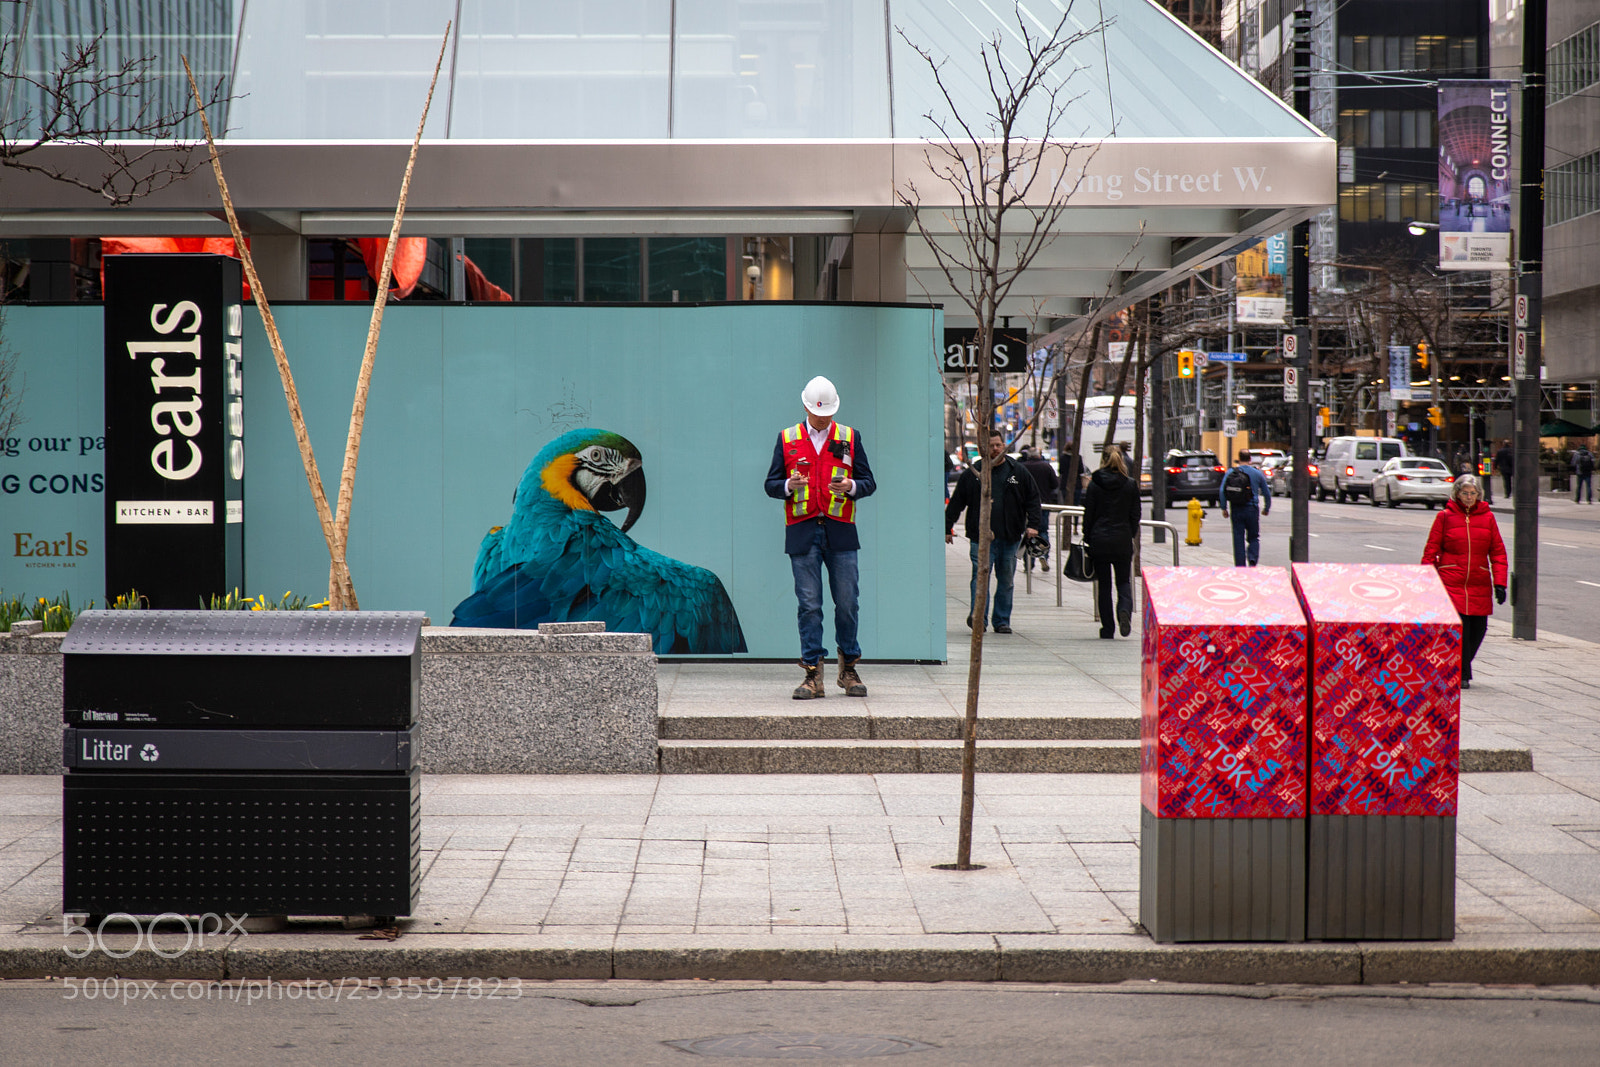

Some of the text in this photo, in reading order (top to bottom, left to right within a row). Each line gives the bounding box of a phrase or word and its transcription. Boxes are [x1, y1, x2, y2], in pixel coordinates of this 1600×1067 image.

[1491, 88, 1508, 181] CONNECT
[1050, 167, 1124, 201] King
[1133, 166, 1223, 193] Street
[1232, 166, 1273, 192] W.
[126, 300, 203, 480] earls
[28, 437, 72, 452] our
[120, 507, 171, 516] KITCHEN
[187, 507, 209, 516] BAR
[13, 531, 89, 557] Earls
[1177, 640, 1211, 673] G5N
[1239, 625, 1270, 657] B3N
[1333, 638, 1367, 671] G5N
[1357, 636, 1389, 669] H9X
[1395, 624, 1426, 655] B3N
[1157, 675, 1183, 701] A1B
[1217, 671, 1256, 709] S4N
[1231, 655, 1270, 695] B2Z
[1312, 672, 1339, 698] A1B
[1373, 669, 1411, 707] S4N
[1386, 653, 1425, 693] B2Z
[1251, 713, 1288, 749] E4P
[1271, 709, 1303, 741] H9X
[1405, 711, 1442, 748] E4P
[1426, 708, 1457, 740] H9X
[82, 737, 132, 761] Litter
[1204, 739, 1252, 788] T9K
[1358, 737, 1405, 786] T9K
[1209, 774, 1241, 806] H9X
[1245, 758, 1282, 793] K4A
[1363, 771, 1394, 804] H9X
[1398, 756, 1436, 791] K4A
[1187, 776, 1225, 813] H1X
[1341, 773, 1378, 811] H1X
